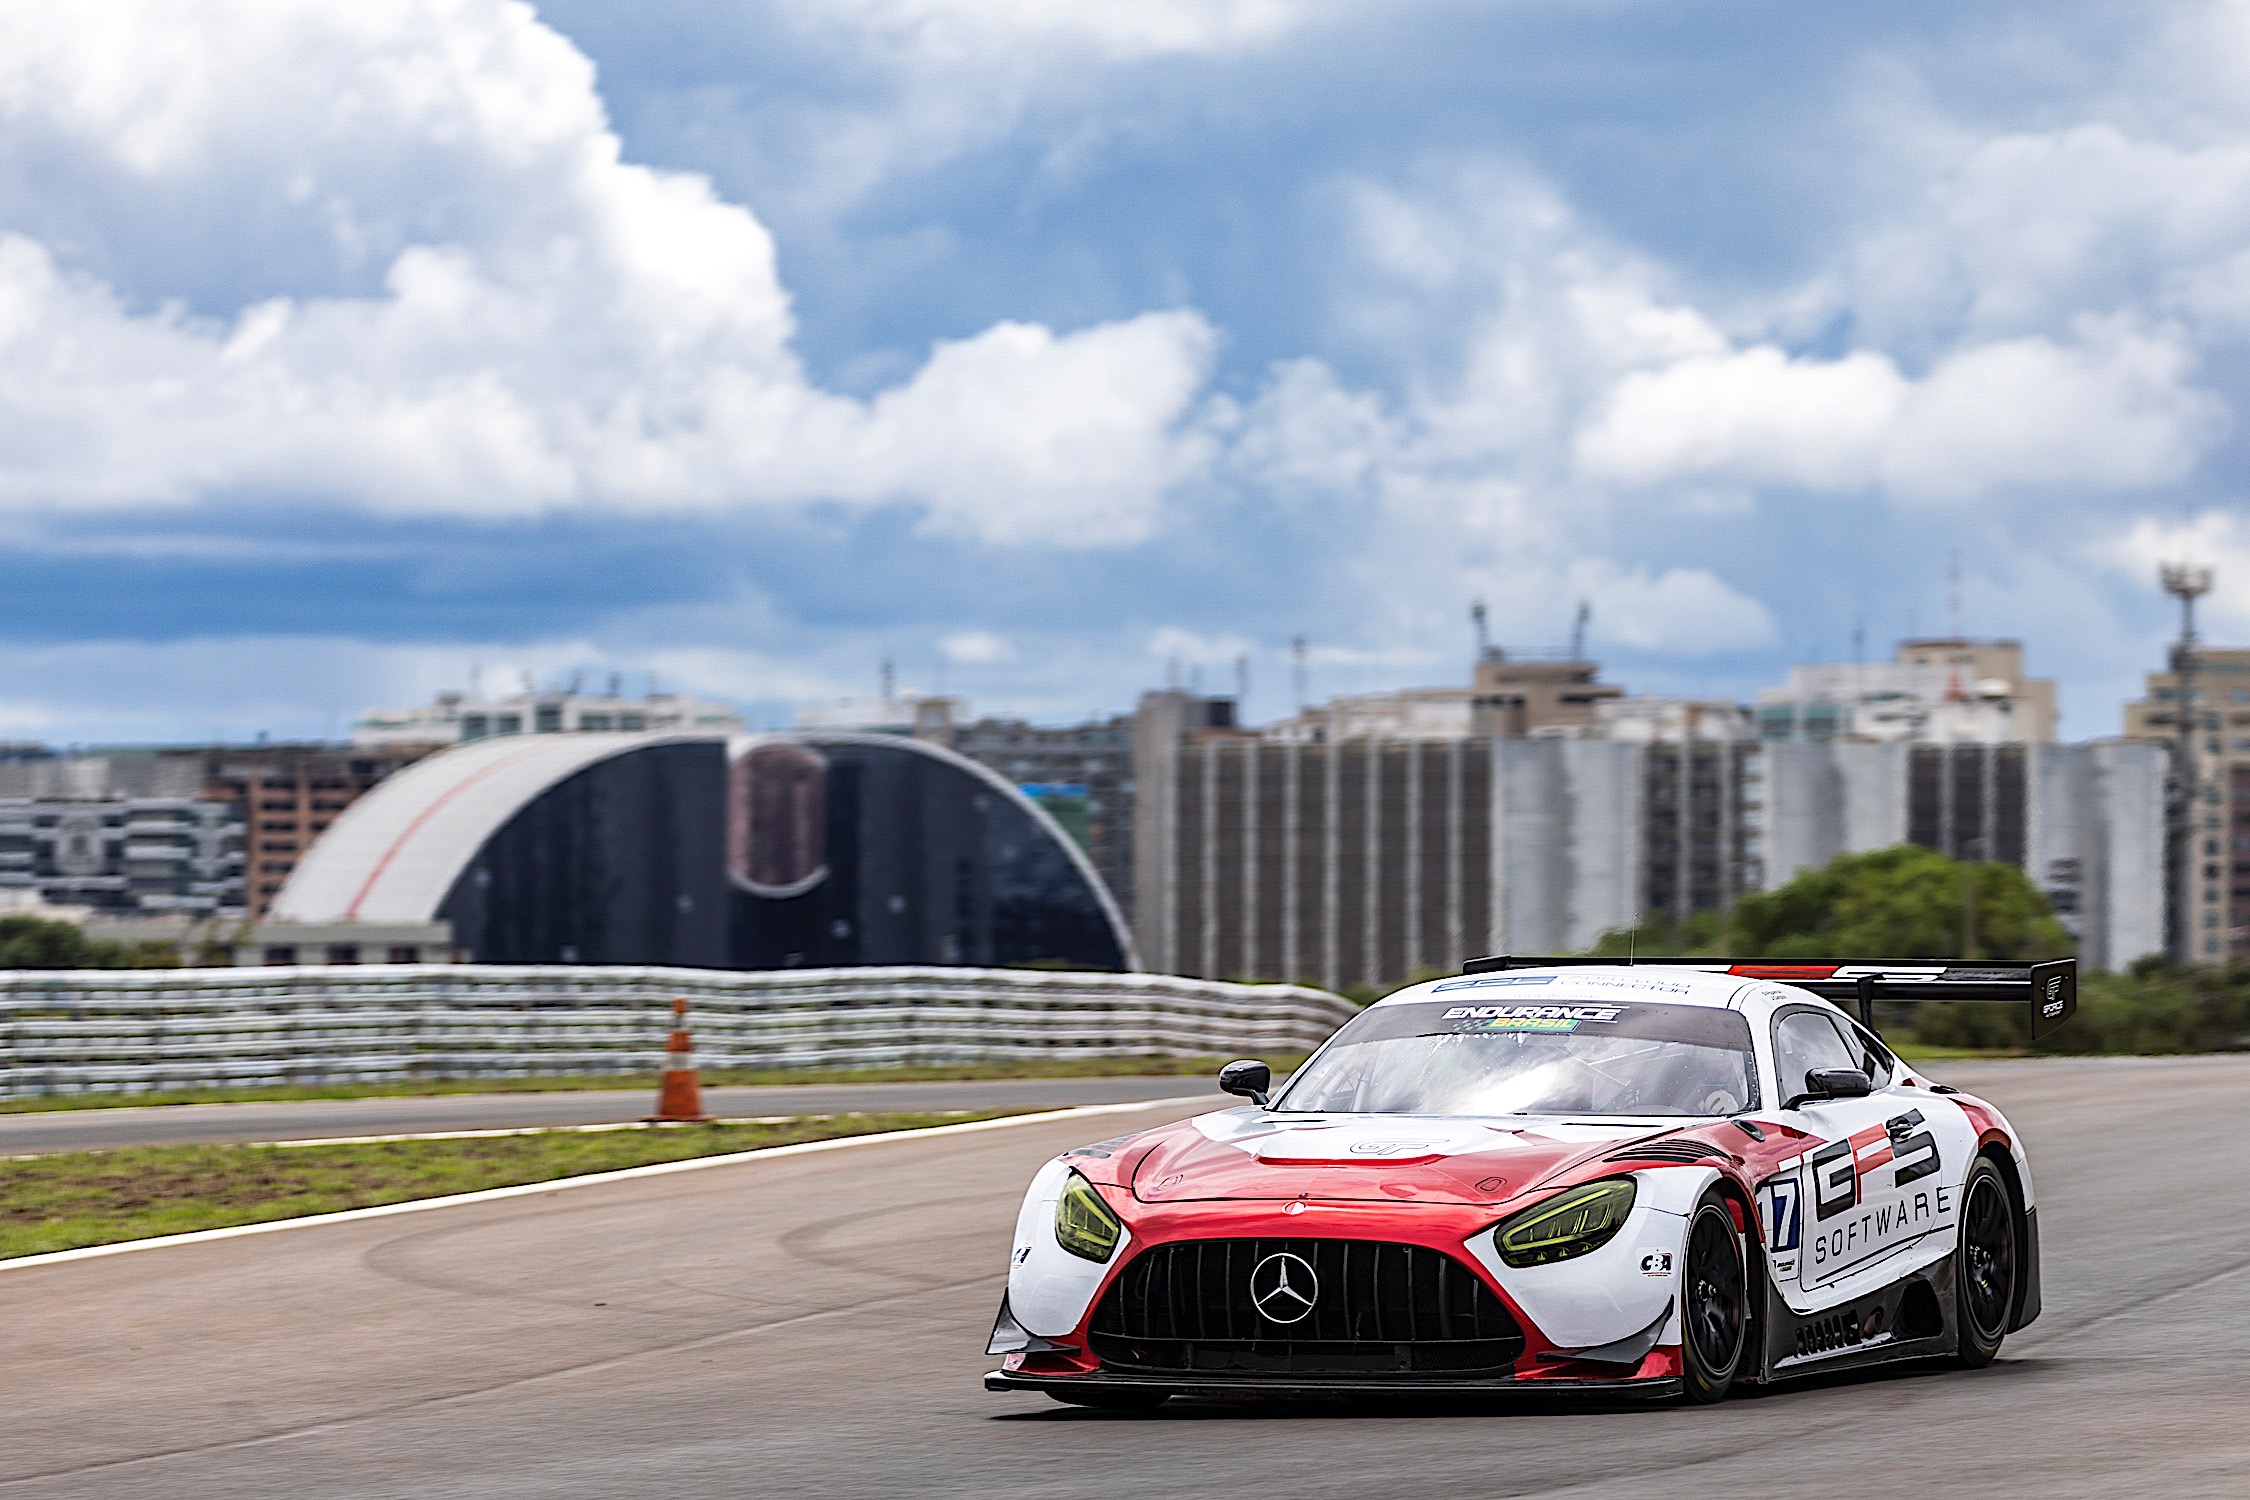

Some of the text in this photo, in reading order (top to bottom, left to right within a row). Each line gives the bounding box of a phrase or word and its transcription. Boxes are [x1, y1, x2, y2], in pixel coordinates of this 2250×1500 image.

[1560, 981, 1689, 995] CONNECTOR
[1442, 1006, 1621, 1020] ENDURANCE
[1490, 1018, 1574, 1028] BRASIL
[1755, 1182, 1795, 1248] 17
[1815, 1187, 1951, 1264] SOFTWARE
[1641, 1253, 1672, 1271] CBA
